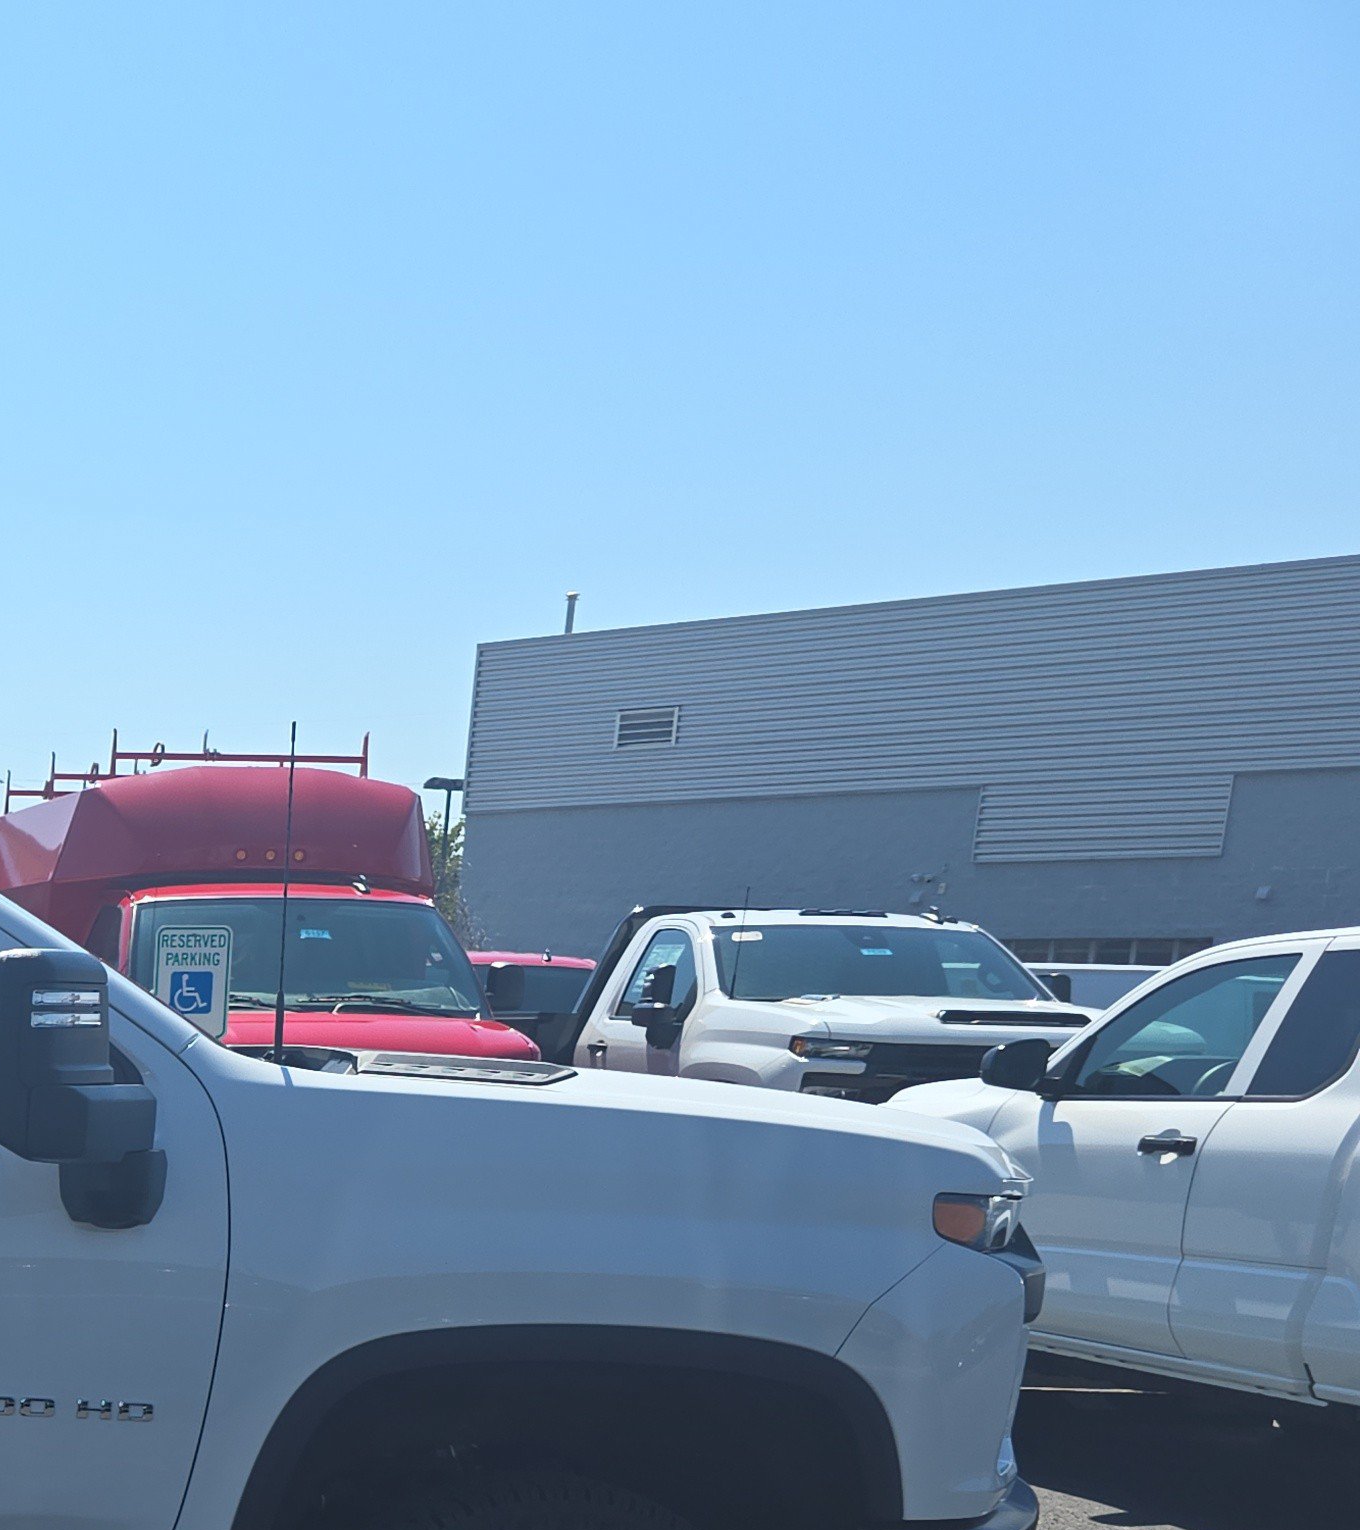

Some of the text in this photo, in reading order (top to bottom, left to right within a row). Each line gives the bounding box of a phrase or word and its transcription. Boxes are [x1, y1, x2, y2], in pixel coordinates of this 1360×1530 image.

[161, 934, 227, 948] RESERVED
[165, 953, 221, 966] PARKING
[76, 1399, 154, 1422] HD
